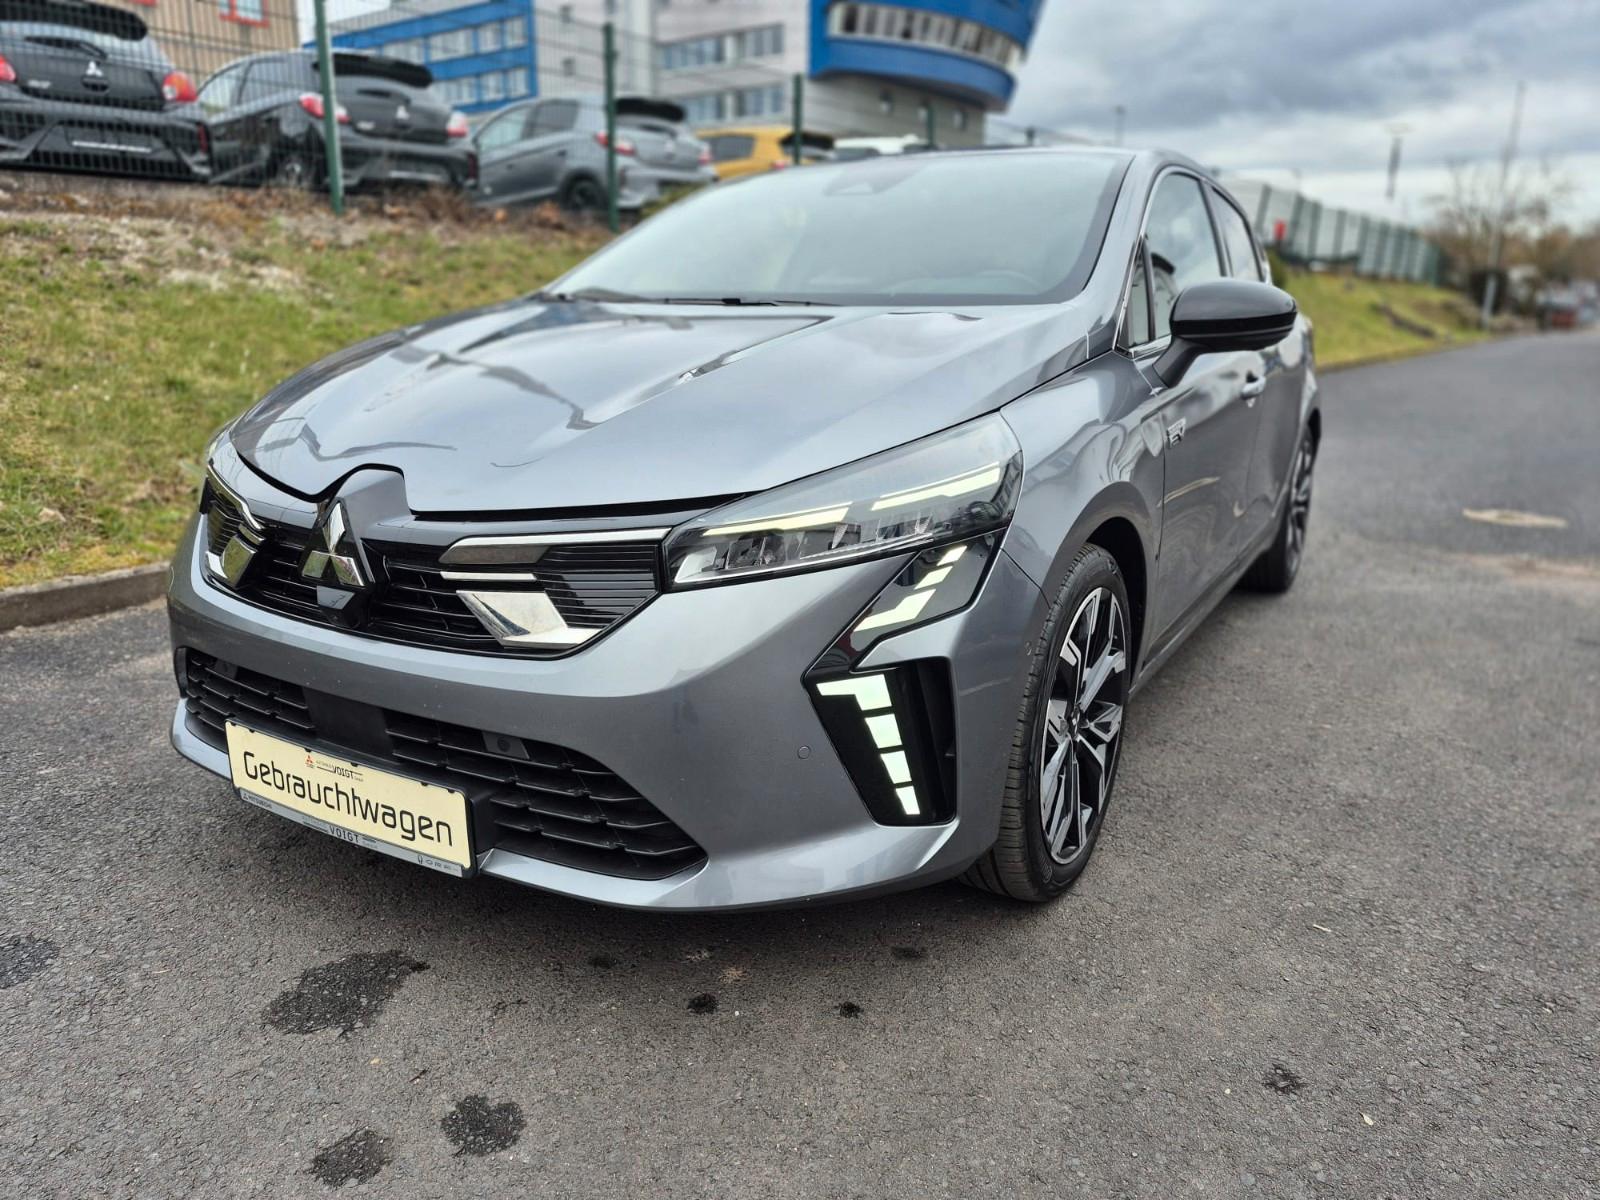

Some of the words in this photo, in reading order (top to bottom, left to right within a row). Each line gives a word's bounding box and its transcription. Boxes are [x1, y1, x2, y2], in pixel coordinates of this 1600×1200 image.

[333, 765, 354, 779] VOIGT
[243, 750, 453, 847] Gebrauchtwagen
[329, 825, 359, 843] VOIGT
